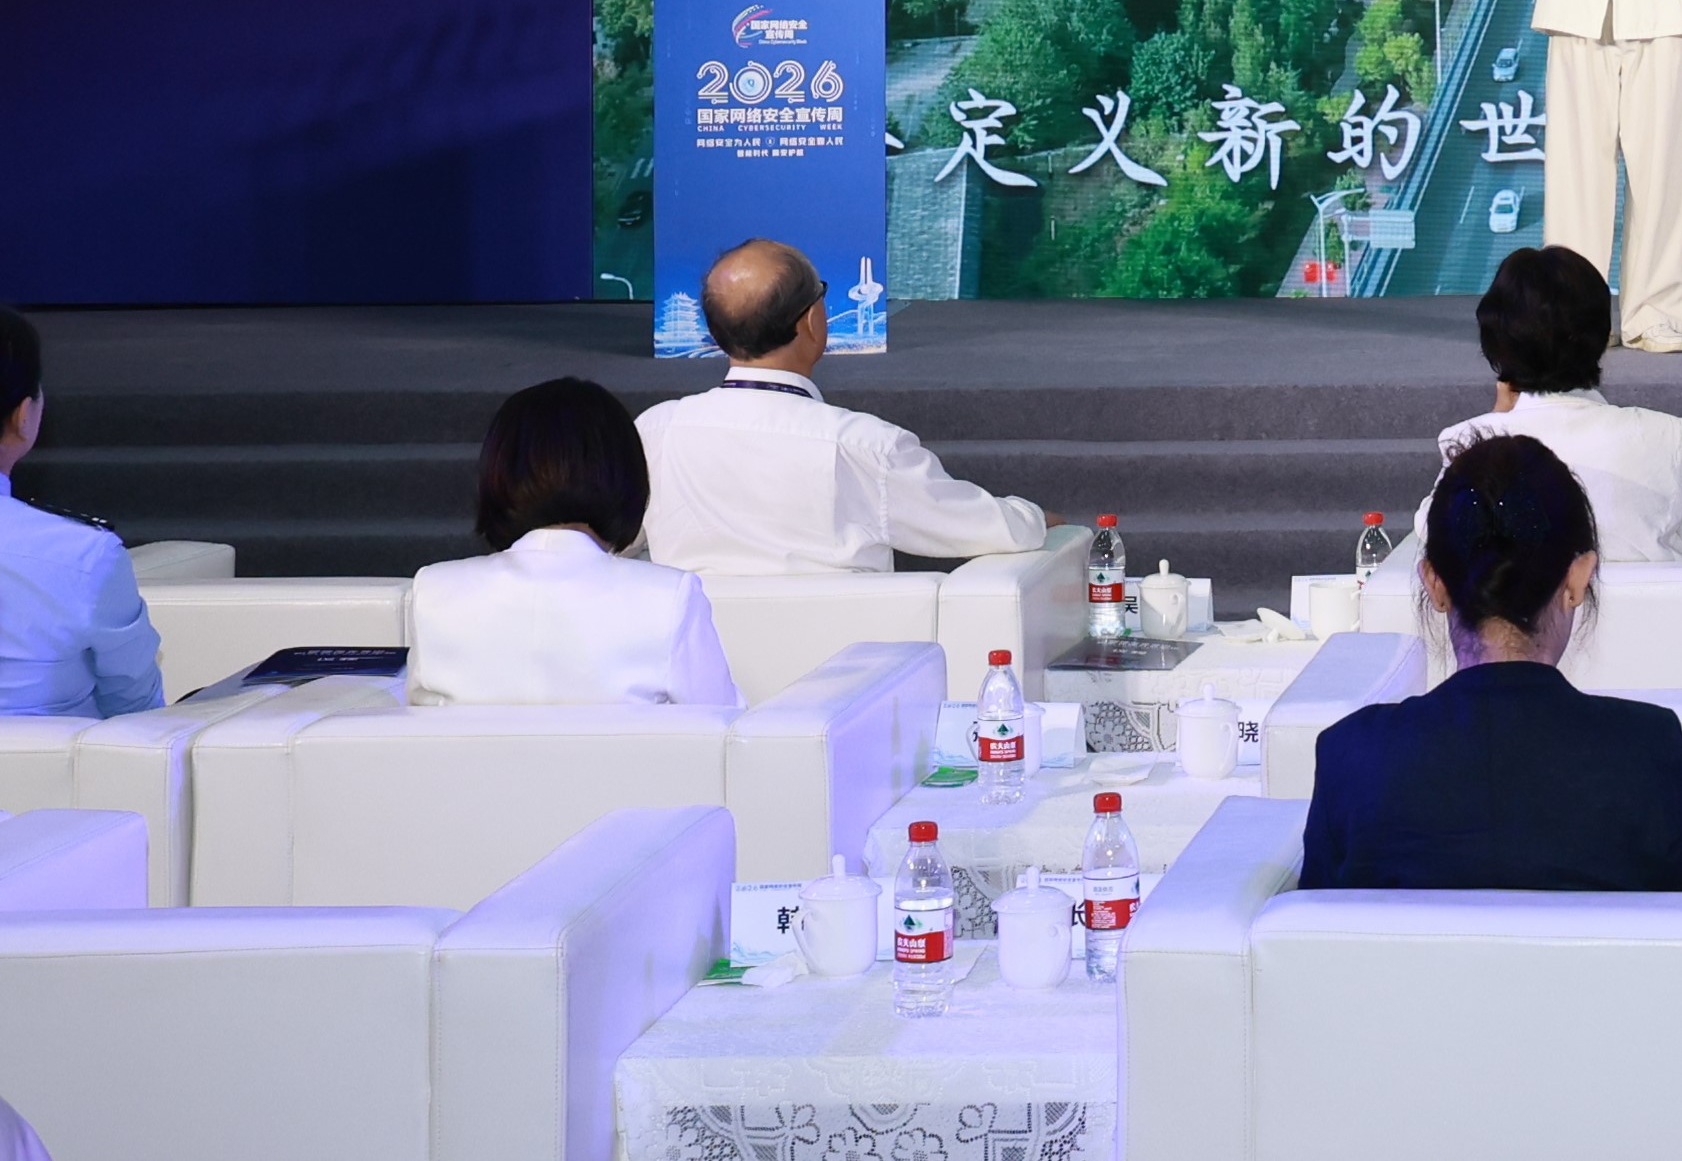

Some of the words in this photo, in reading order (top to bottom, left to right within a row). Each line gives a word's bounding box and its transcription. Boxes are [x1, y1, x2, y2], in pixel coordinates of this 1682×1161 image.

[697, 60, 844, 104] 2026
[697, 107, 843, 124] 国家网络安全宣传周
[886, 84, 1546, 190] 定义新的世
